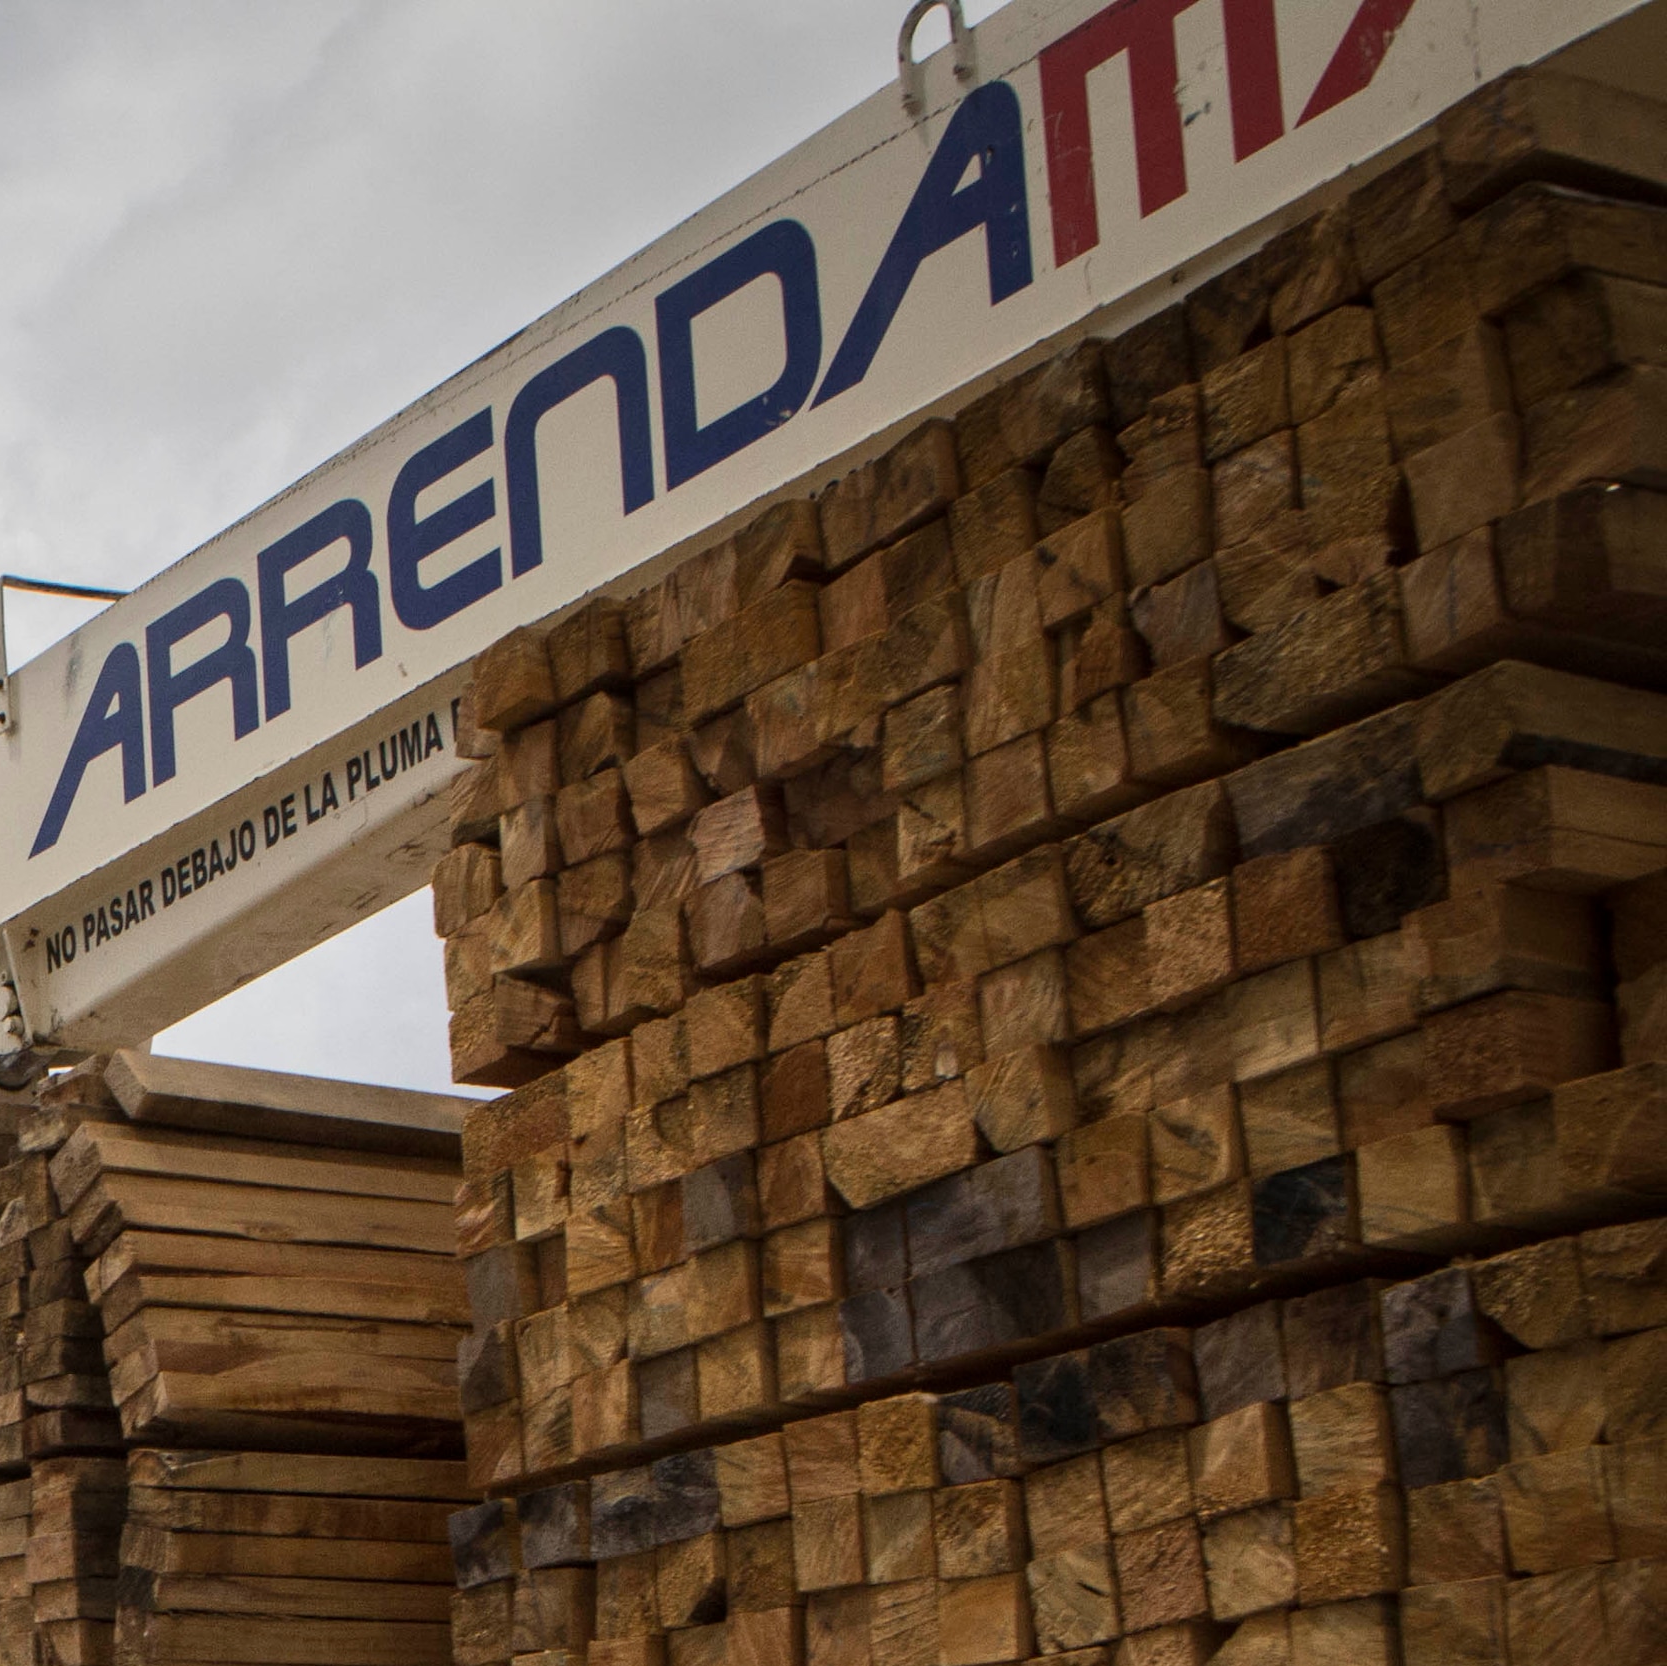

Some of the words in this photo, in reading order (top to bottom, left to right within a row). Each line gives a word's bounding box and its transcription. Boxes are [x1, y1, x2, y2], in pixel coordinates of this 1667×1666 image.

[46, 926, 77, 974] NO
[82, 879, 156, 953] PASAR
[162, 820, 256, 909] DEBAJO
[264, 792, 297, 849] DE
[304, 772, 339, 826] LA
[346, 712, 444, 802] PLUMA
